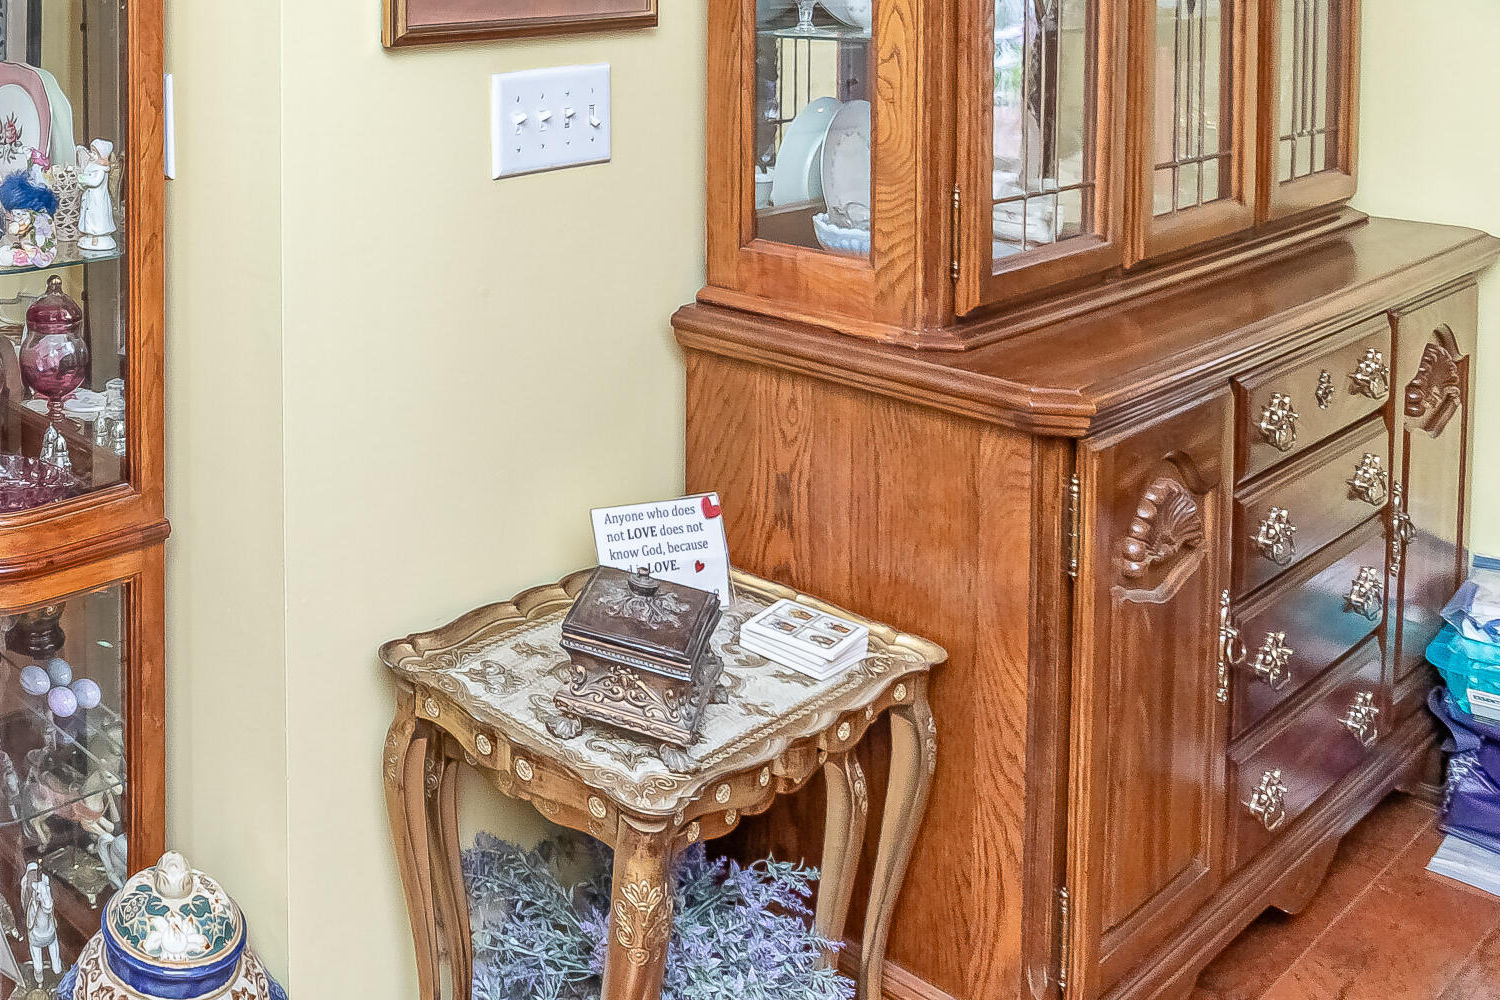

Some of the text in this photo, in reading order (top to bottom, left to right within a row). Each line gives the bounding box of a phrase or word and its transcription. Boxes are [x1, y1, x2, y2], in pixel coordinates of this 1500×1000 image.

[604, 505, 696, 526] Anyone who does
[606, 522, 704, 543] not LOVE does not
[609, 540, 709, 561] know God, because
[647, 560, 680, 574] LOVE.
